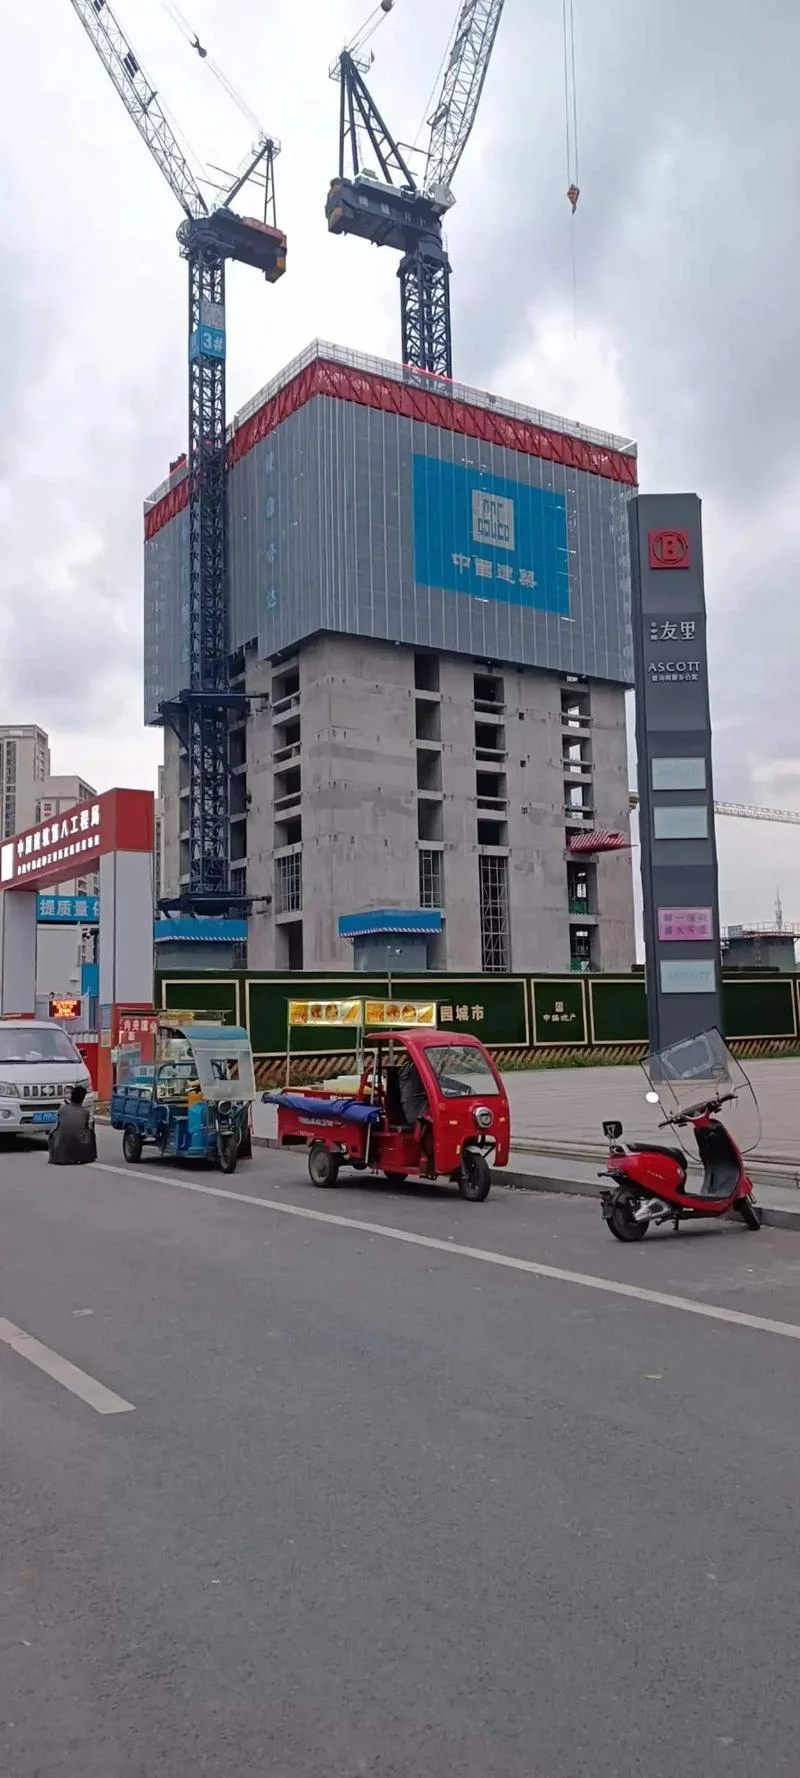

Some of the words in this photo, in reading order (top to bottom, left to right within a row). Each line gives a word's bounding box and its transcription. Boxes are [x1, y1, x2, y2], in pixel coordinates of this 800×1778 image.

[203, 332, 223, 352] 3#
[659, 621, 695, 640] 友里
[648, 661, 700, 672] ASCOTT
[440, 1004, 485, 1022] 园城市
